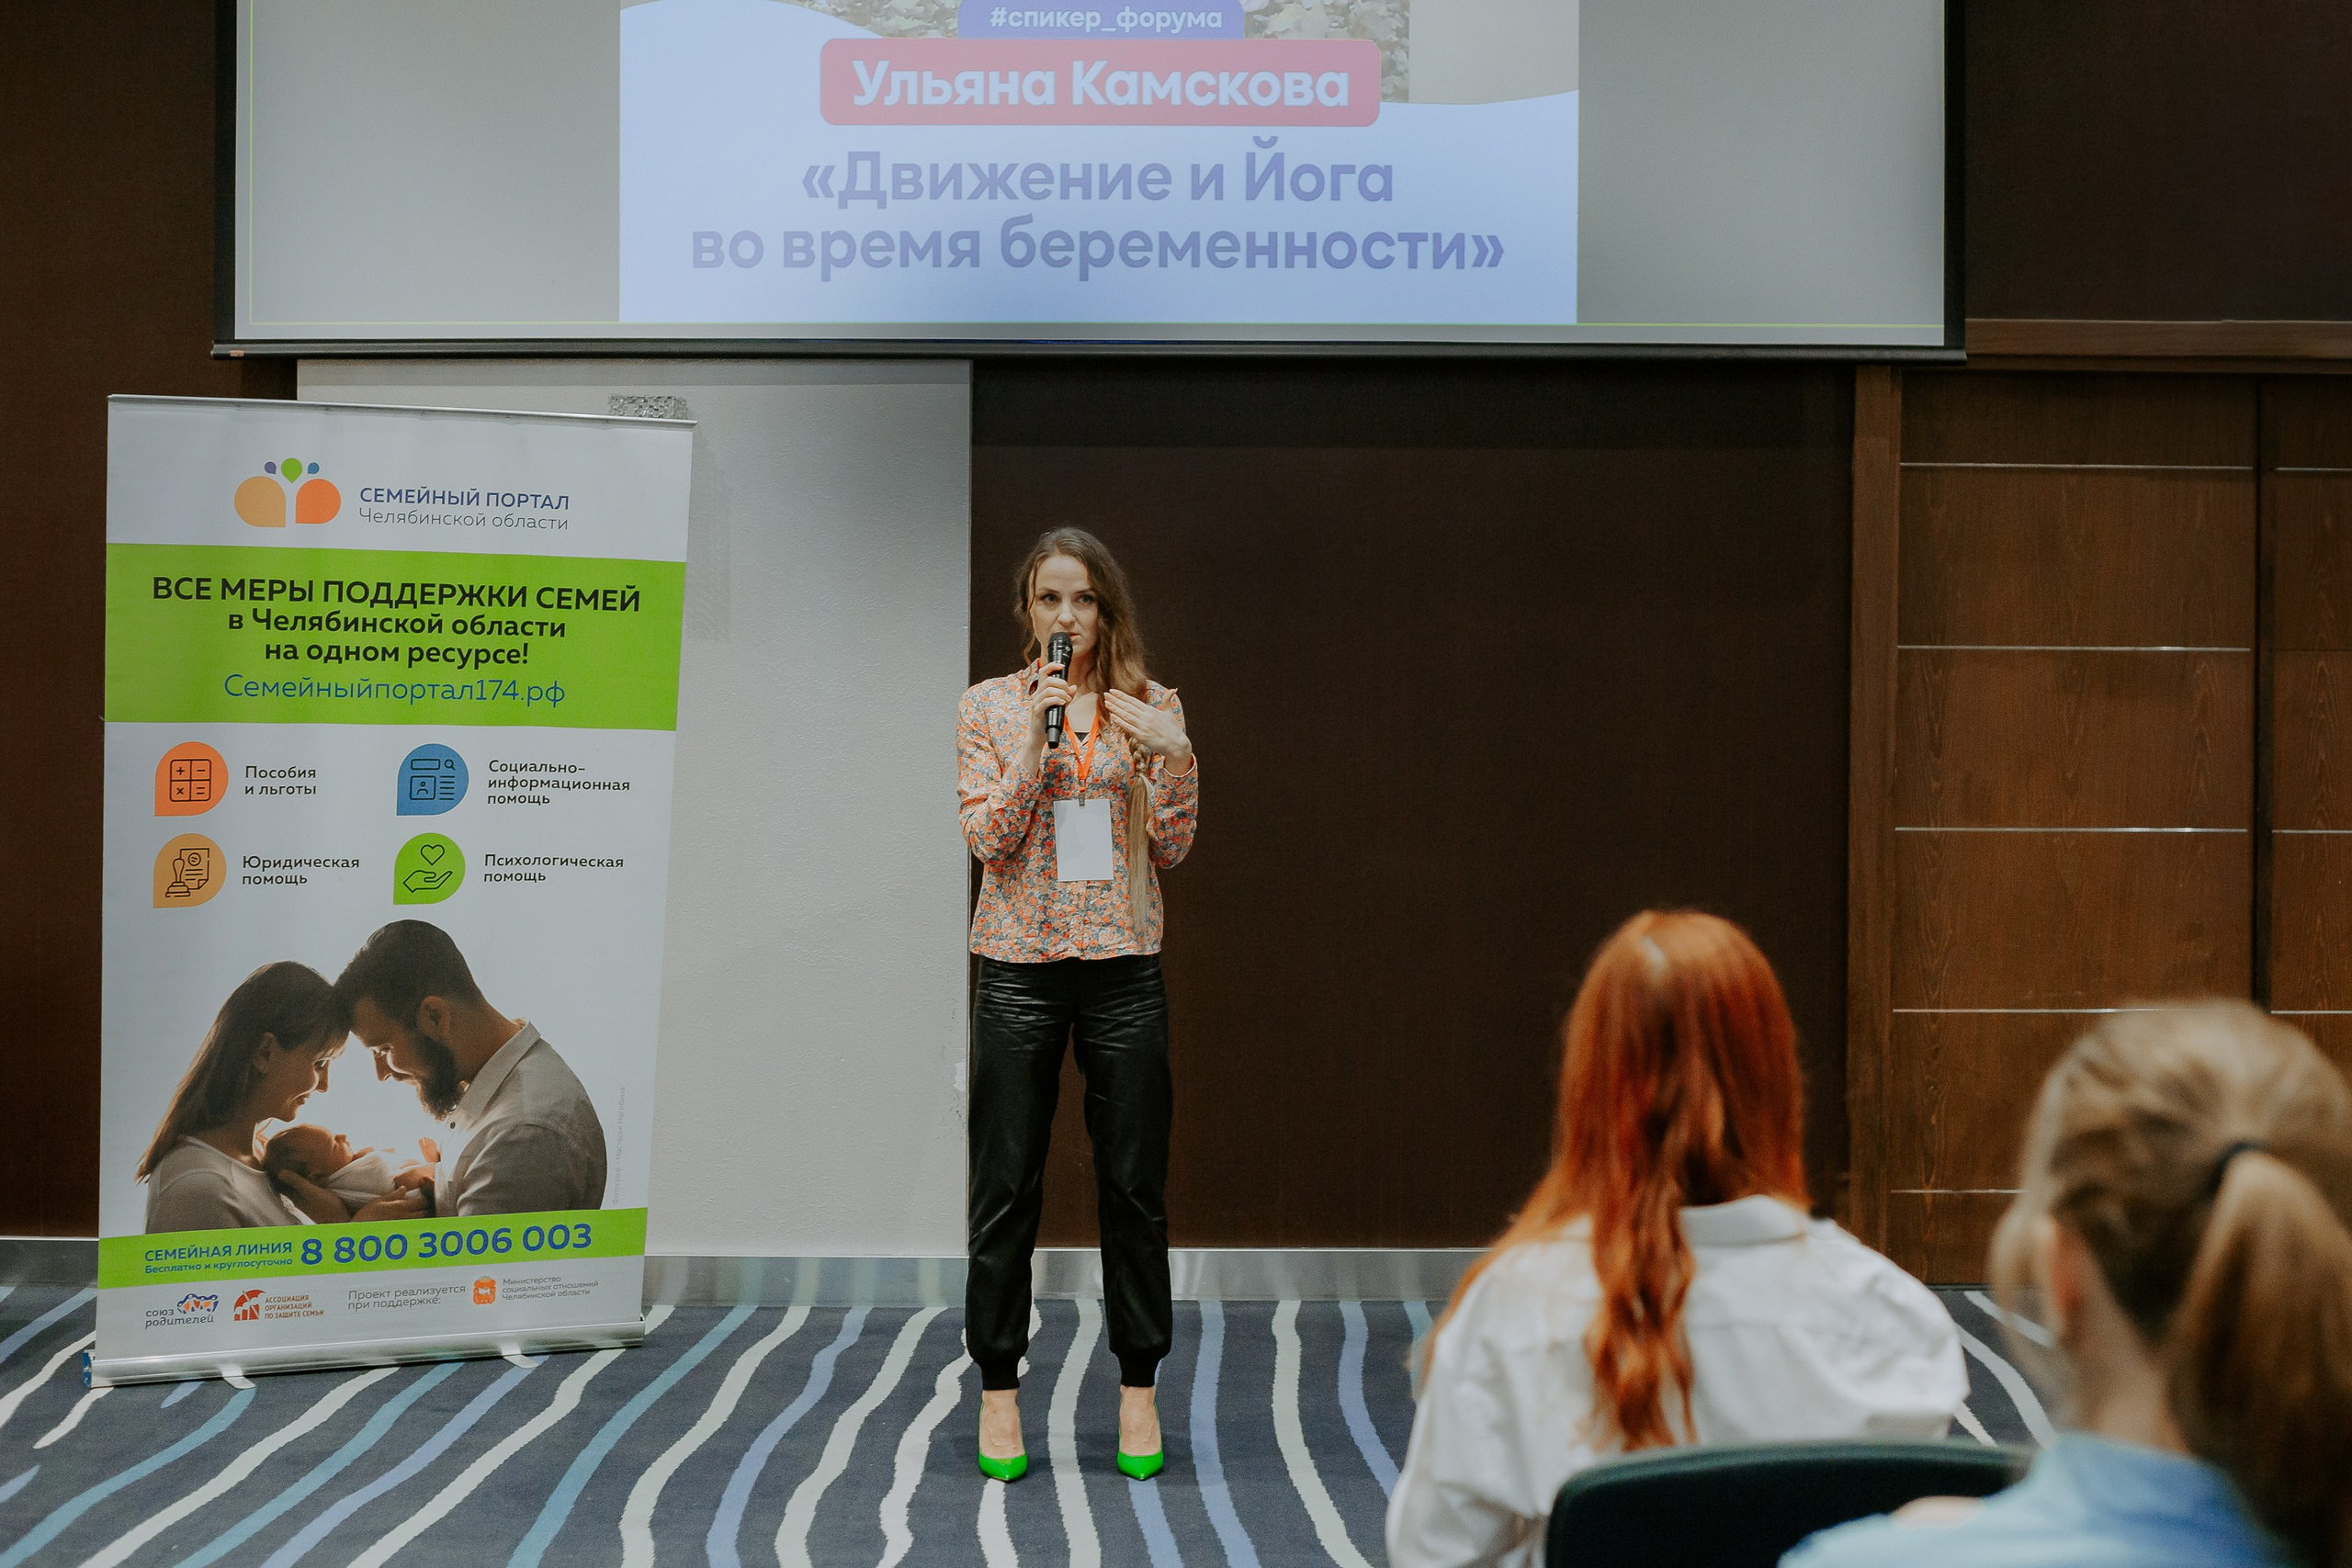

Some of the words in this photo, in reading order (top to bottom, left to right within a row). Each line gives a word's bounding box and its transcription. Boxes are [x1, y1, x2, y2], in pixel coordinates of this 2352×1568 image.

[989, 6, 1223, 34] #спикер_форума
[852, 59, 1057, 108] Ульяна
[1070, 59, 1350, 108] Камскова
[802, 150, 1173, 210] «Движение
[1189, 159, 1224, 200] и
[1245, 134, 1394, 203] Йога
[691, 230, 764, 269] во
[783, 229, 981, 283] время
[1000, 214, 1505, 282] беременности»
[359, 486, 481, 507] СЕМЕЙНЫЙ
[486, 492, 570, 511] ПОРТАЛ
[359, 507, 486, 527] Челябинской
[492, 513, 569, 530] области
[153, 577, 212, 601] ВСЕ
[221, 578, 314, 603] МЕРЫ
[323, 581, 527, 609] ПОДДЕРЖКИ
[536, 584, 641, 613] СЕМЕЙ
[228, 614, 243, 630] в
[252, 608, 444, 636] Челябинской
[452, 613, 566, 637] области
[265, 645, 299, 662] на
[307, 645, 400, 667] одном
[408, 643, 529, 670] ресурсе!
[224, 673, 566, 707] Семейныйпортал174.рф
[244, 765, 317, 781] Пособия
[488, 760, 586, 776] Социально-
[244, 784, 254, 795] и
[258, 784, 317, 795] льготы
[488, 775, 631, 792] информационная
[487, 793, 551, 807] помощь
[242, 855, 360, 872] Юридическая
[484, 853, 625, 871] Психологическая
[242, 873, 309, 886] помощь
[483, 870, 547, 884] помощь
[144, 1245, 232, 1262] СЕМЕЙНАЯ
[235, 1241, 293, 1257] ЛИНИЯ
[300, 1237, 322, 1266] 8
[334, 1235, 408, 1263] 800
[418, 1228, 513, 1258] 3006
[522, 1223, 593, 1252] 003
[144, 1263, 201, 1274] Бесплатно
[213, 1258, 293, 1270] круглосуточно
[503, 1276, 561, 1286] Министерство
[503, 1284, 551, 1294] социальных
[553, 1280, 599, 1289] отношений
[265, 1295, 309, 1303] АССОЦИАЦИЯ
[348, 1290, 391, 1301] Проект
[394, 1285, 466, 1299] реализуется
[503, 1291, 556, 1301] Челябинской
[557, 1288, 591, 1297] области
[265, 1302, 312, 1311] ОРГАНИЗАЦИЙ
[348, 1301, 369, 1311] при
[373, 1297, 441, 1309] поддержке:
[145, 1309, 175, 1317] союз
[275, 1311, 301, 1319] ЗАЩИТЕ
[145, 1314, 214, 1329] родителей
